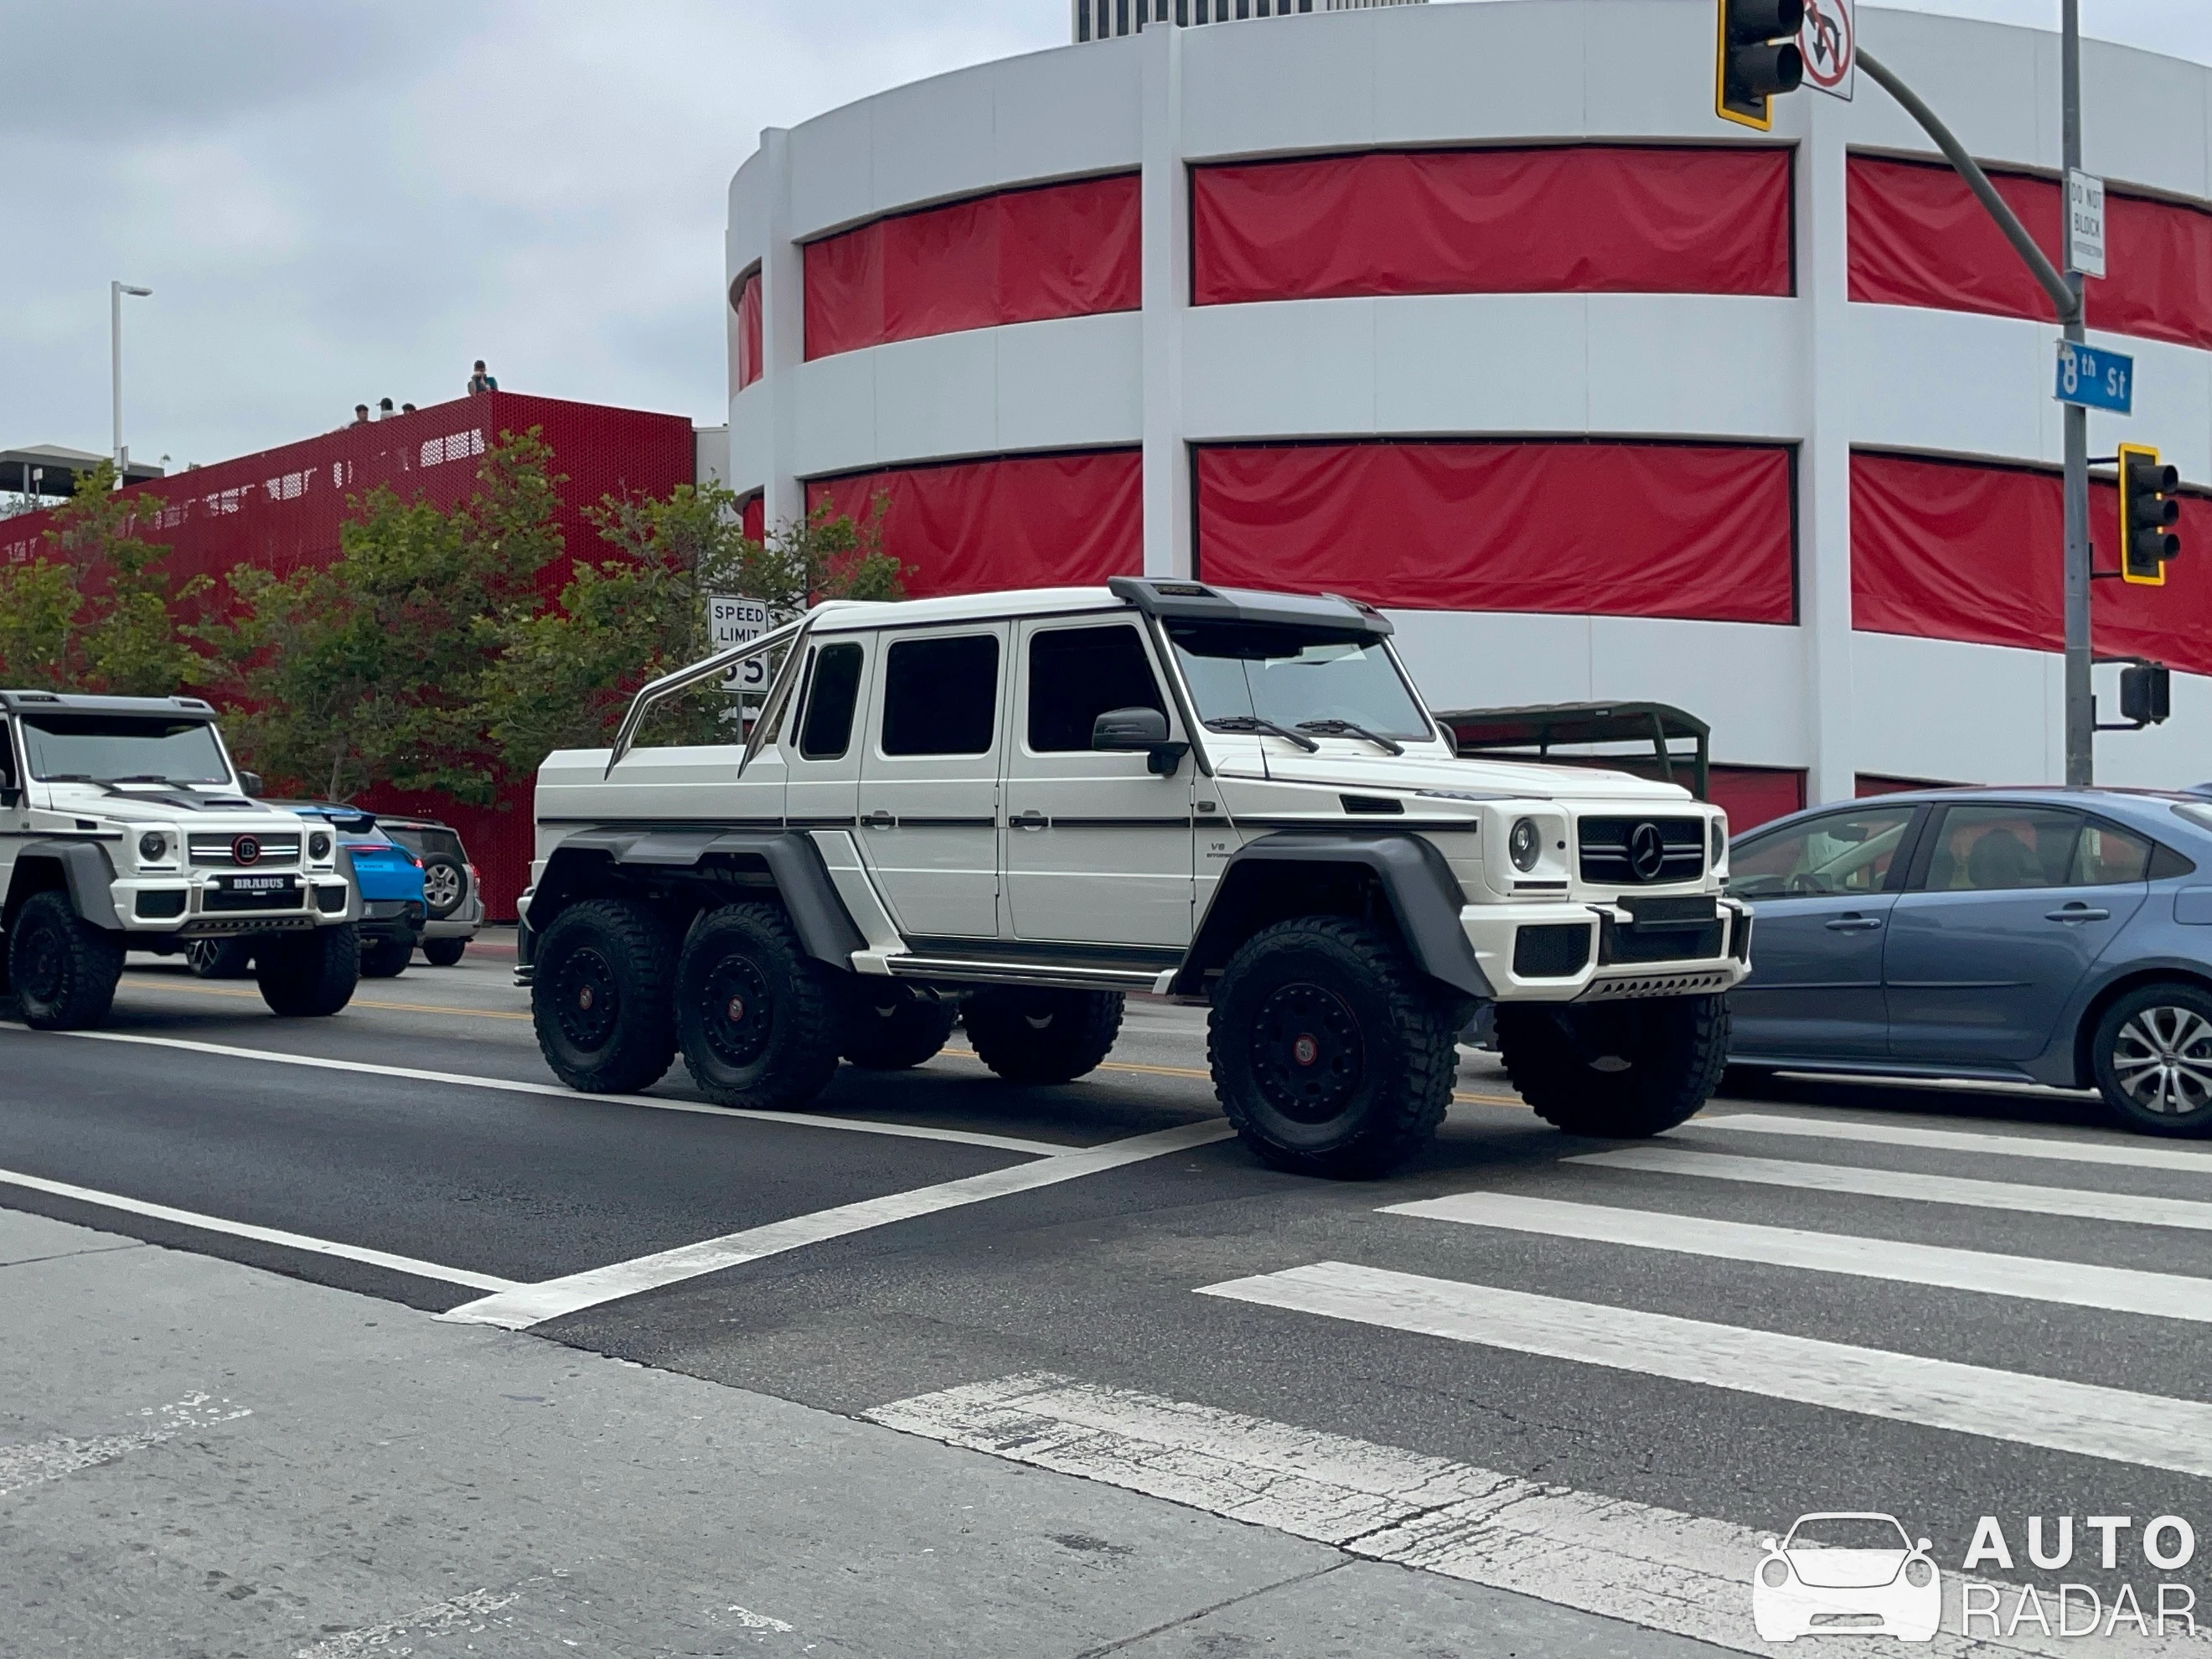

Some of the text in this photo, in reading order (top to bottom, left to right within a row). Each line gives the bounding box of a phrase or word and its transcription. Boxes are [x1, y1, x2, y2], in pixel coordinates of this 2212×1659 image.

[2071, 183, 2102, 209] DO NOT
[2073, 212, 2101, 238] BLOCK
[2063, 349, 2126, 399] 8th St
[715, 605, 764, 623] SPEED
[721, 627, 759, 643] LIMIT
[234, 878, 284, 889] BRABUS
